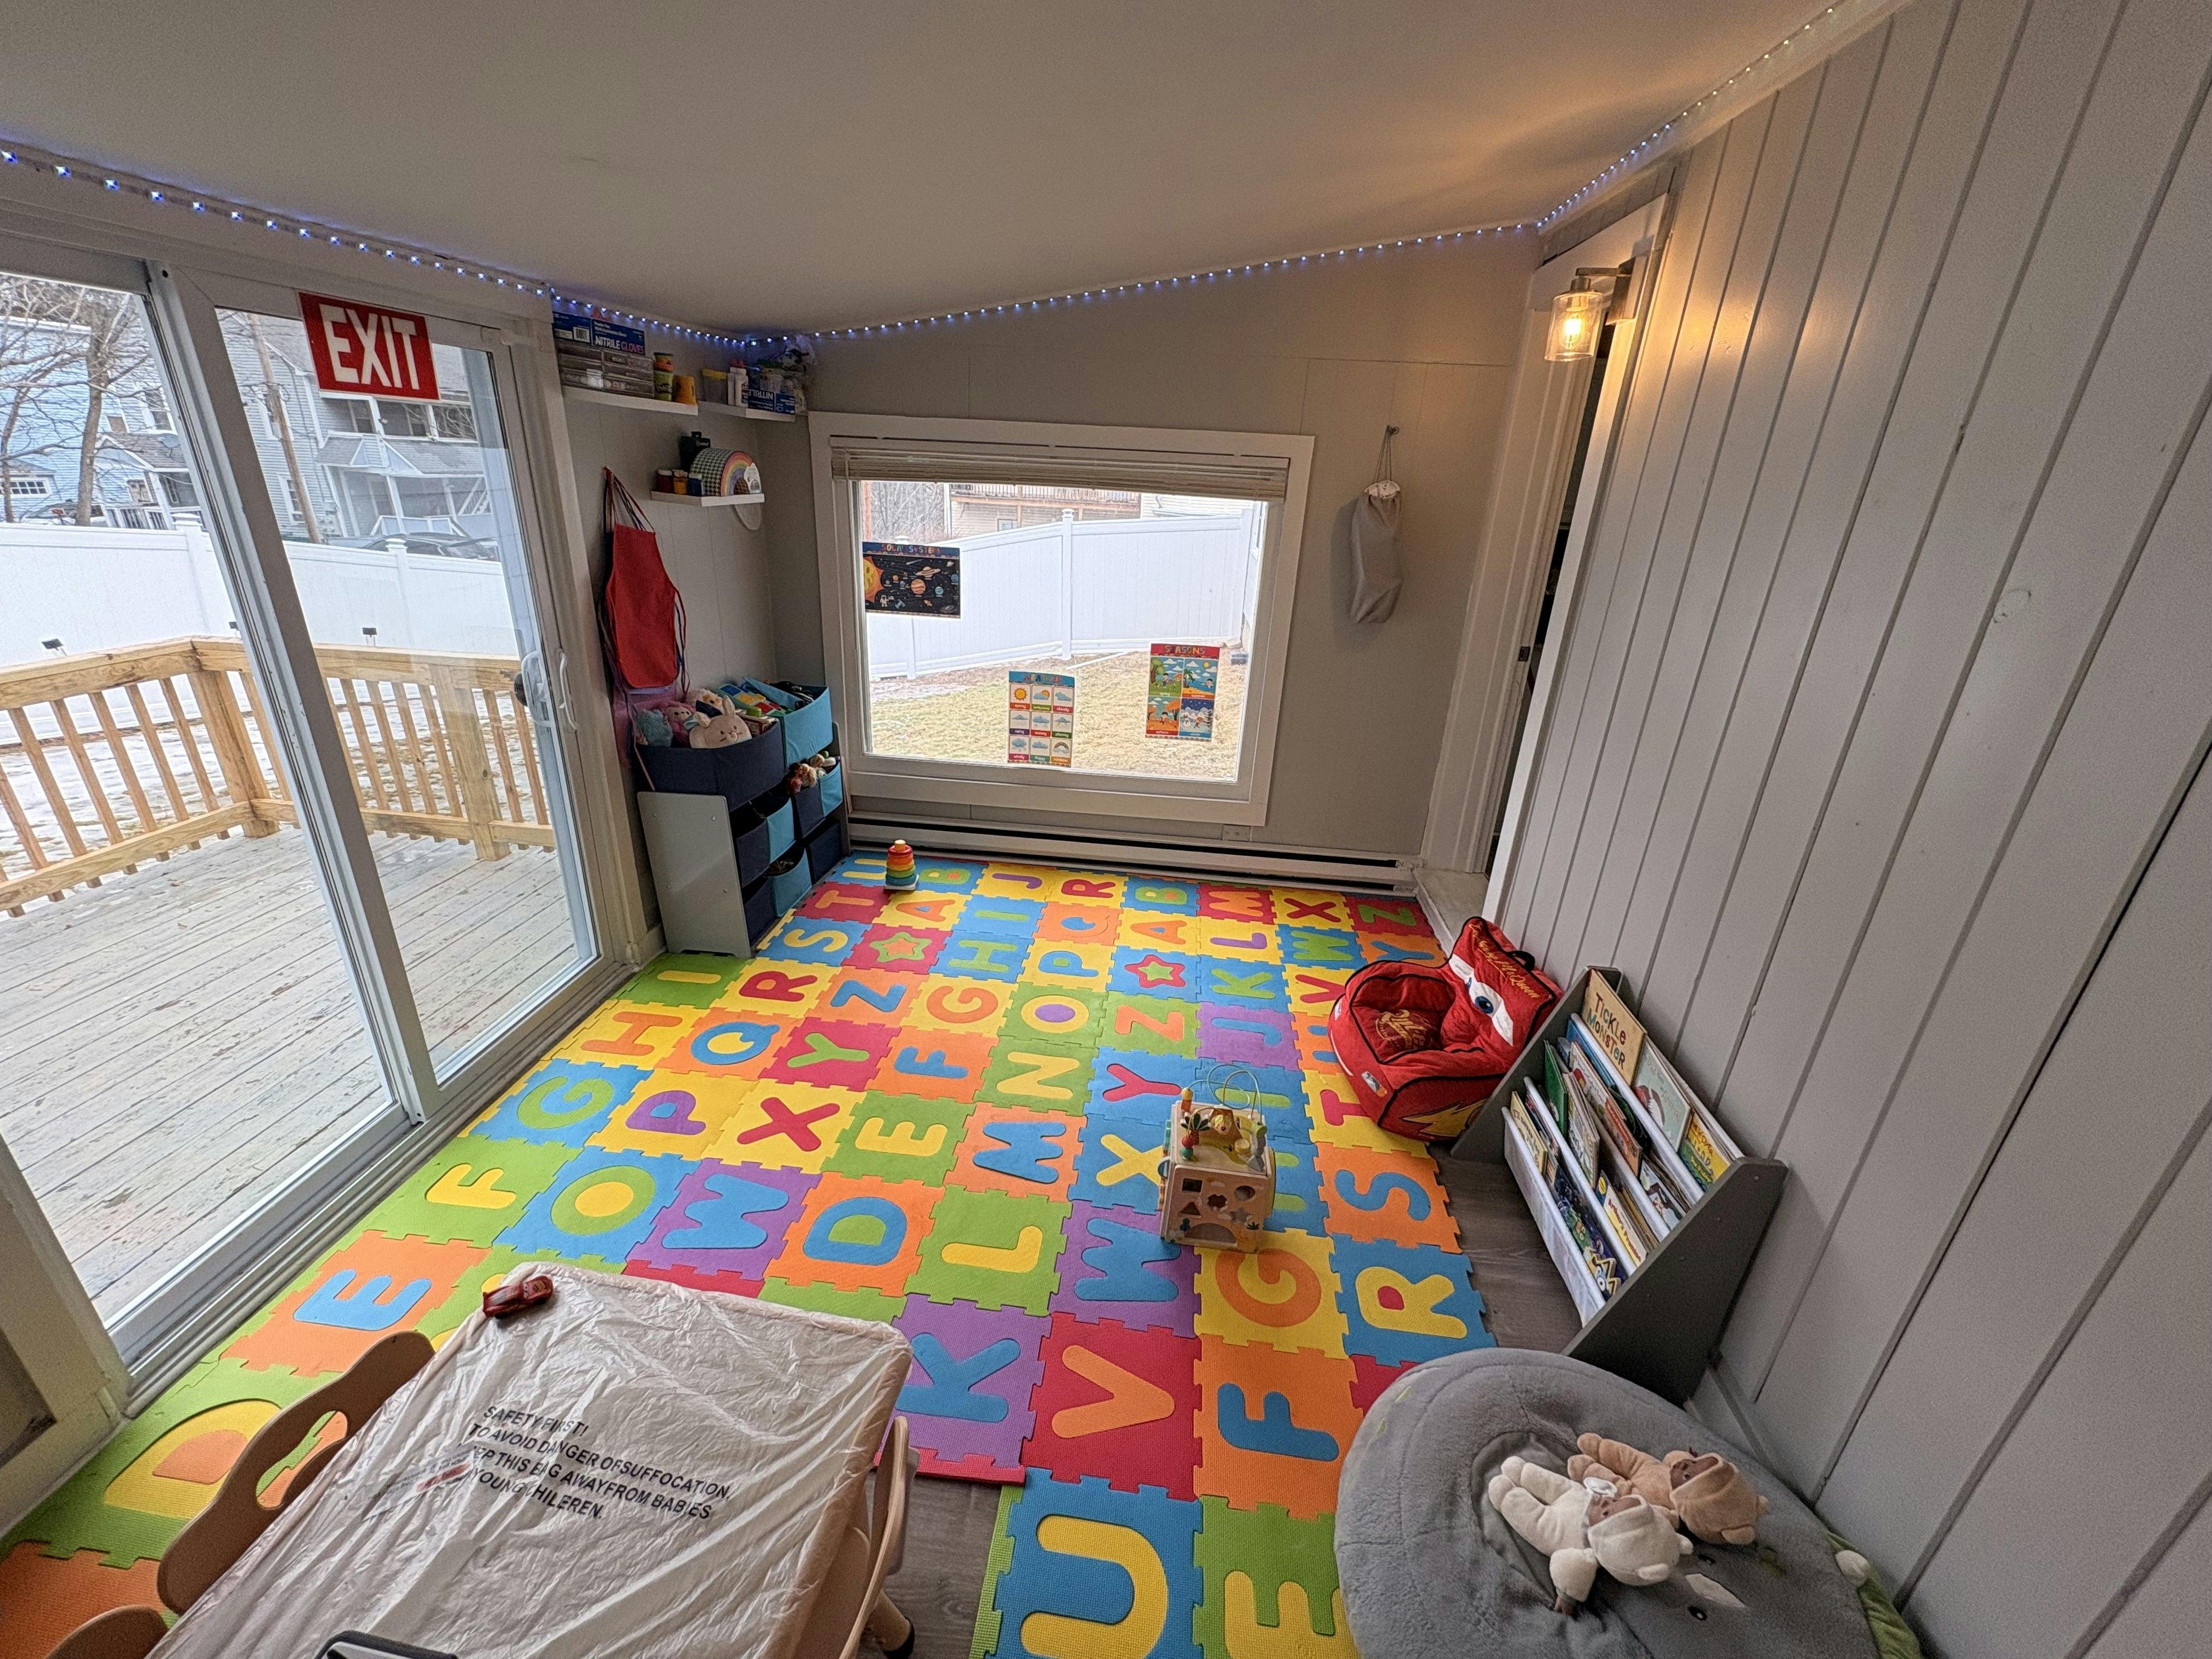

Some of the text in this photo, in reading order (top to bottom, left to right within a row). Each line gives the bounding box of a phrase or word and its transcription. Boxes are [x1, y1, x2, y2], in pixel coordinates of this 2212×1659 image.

[319, 303, 420, 390] EXIT
[595, 335, 620, 350] NITRILE
[620, 341, 644, 354] GLOVES
[748, 389, 773, 400] NITRILE
[881, 544, 940, 554] SOLAR SYSTEM
[1164, 645, 1205, 654] SEASONS
[1024, 674, 1062, 682] WEATHER
[919, 867, 971, 884] B
[992, 873, 1042, 889] J
[1060, 879, 1115, 899] R
[815, 889, 874, 909] T
[896, 899, 956, 922] A
[1135, 886, 1188, 905] B
[1284, 898, 1337, 923] X
[783, 929, 848, 952] S
[1130, 921, 1187, 945] A
[1210, 933, 1268, 950] L
[1370, 940, 1435, 961] Y
[948, 939, 1018, 972] H
[1038, 951, 1099, 977] P
[740, 970, 818, 1002] R
[1211, 968, 1277, 1000] K
[1494, 960, 1541, 999] McQueen
[926, 985, 998, 1023] G
[1020, 995, 1090, 1033] O
[580, 1011, 683, 1056] H
[690, 1021, 781, 1065] Q
[787, 1032, 870, 1068] Y
[1211, 1017, 1283, 1046] J
[894, 1046, 968, 1079] F
[1102, 1063, 1182, 1102] Y
[517, 1076, 614, 1129] G
[625, 1090, 706, 1136] P
[736, 1097, 840, 1152] X
[855, 1116, 948, 1157] E
[973, 1122, 1067, 1184] M
[425, 1163, 517, 1209] F
[550, 1165, 657, 1237] O
[1335, 1169, 1432, 1221] S
[802, 1196, 908, 1266] D
[941, 1225, 1043, 1273] L
[294, 1269, 432, 1331] E
[1215, 1246, 1322, 1328] G
[1355, 1266, 1468, 1339] R
[896, 1333, 1021, 1424] K
[1051, 1345, 1175, 1439] V
[483, 1406, 589, 1437] SAFETY FIRST!
[1217, 1383, 1340, 1462] F
[469, 1423, 490, 1437] TO
[488, 1429, 538, 1450] AVOID
[537, 1440, 600, 1467] DANGER
[471, 1467, 527, 1493] YOUNG
[495, 1452, 531, 1472] THIS
[529, 1458, 562, 1479] BAG
[650, 1494, 713, 1519] BABIES
[1020, 1514, 1169, 1659] U
